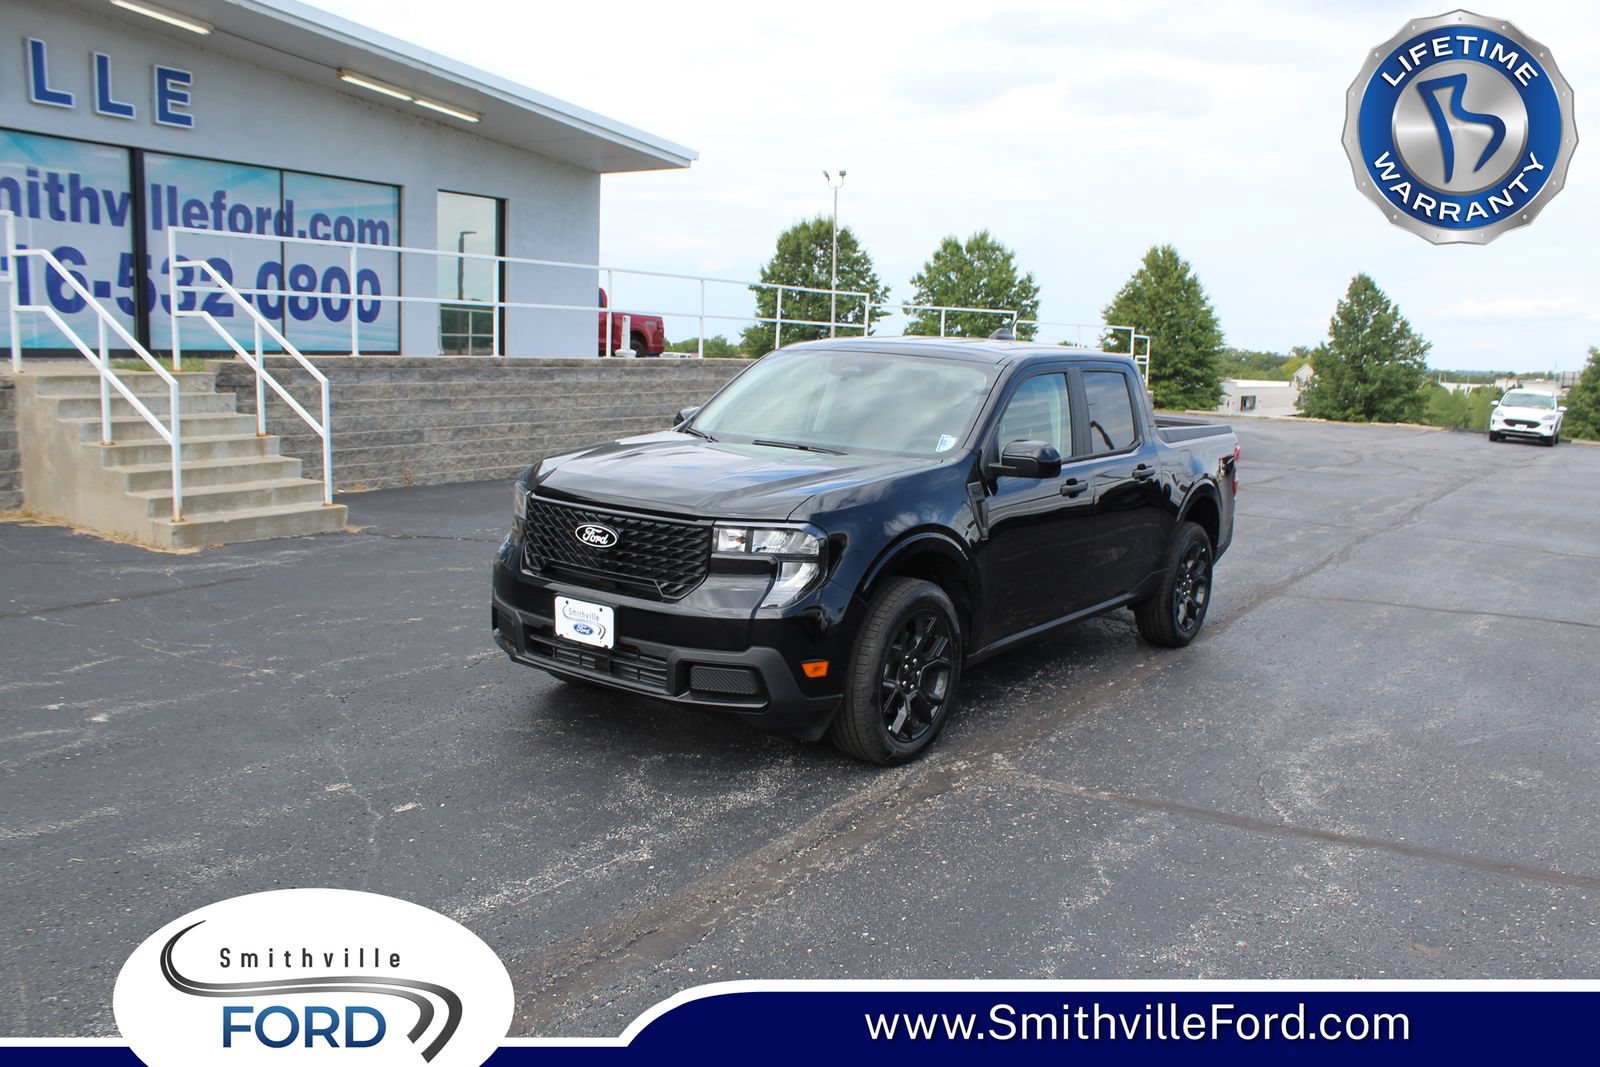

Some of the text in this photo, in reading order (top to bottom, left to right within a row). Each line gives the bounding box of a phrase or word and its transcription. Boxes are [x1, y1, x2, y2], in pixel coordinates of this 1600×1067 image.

[24, 35, 195, 129] LLE
[582, 526, 609, 545] Ford
[568, 607, 600, 622] Smithville
